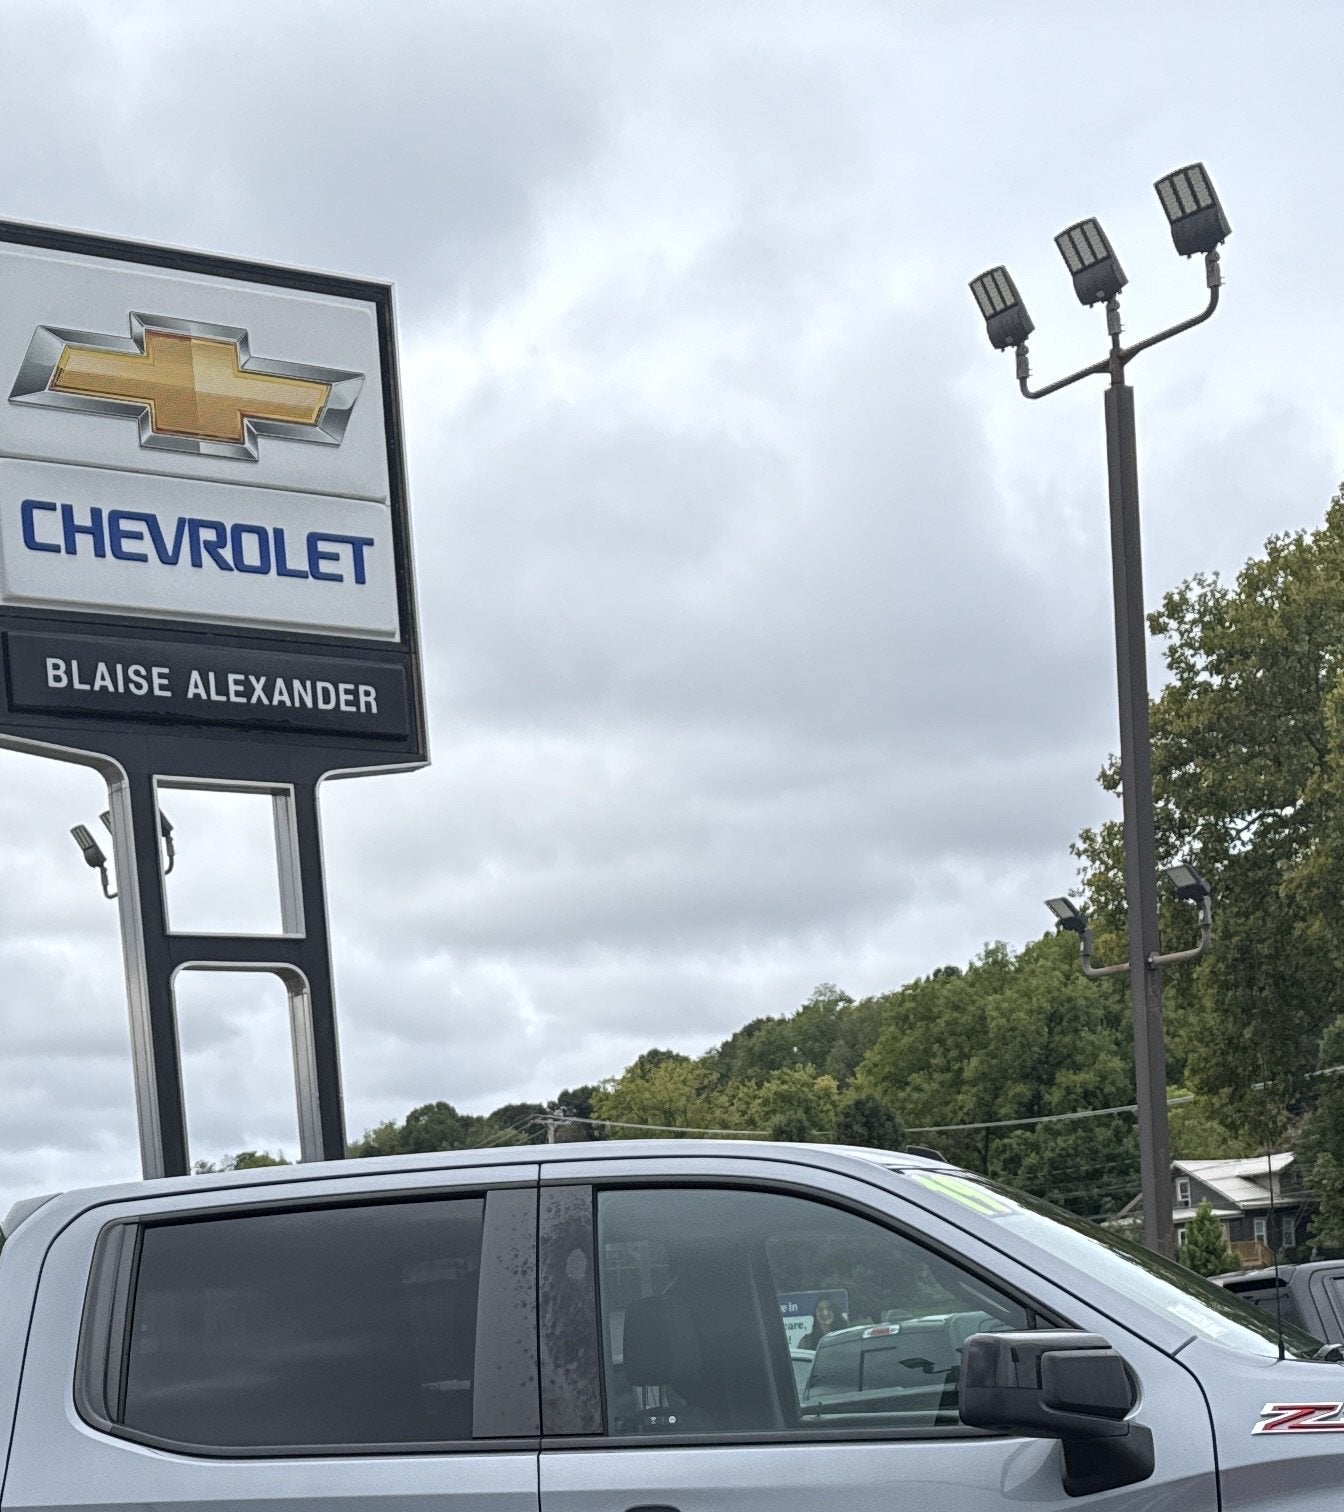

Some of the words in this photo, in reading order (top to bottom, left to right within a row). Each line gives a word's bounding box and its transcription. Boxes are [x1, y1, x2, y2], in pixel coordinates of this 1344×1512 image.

[20, 498, 375, 585] CHEVROLET
[45, 657, 172, 698] BLAISE
[187, 669, 378, 715] ALEXANDER
